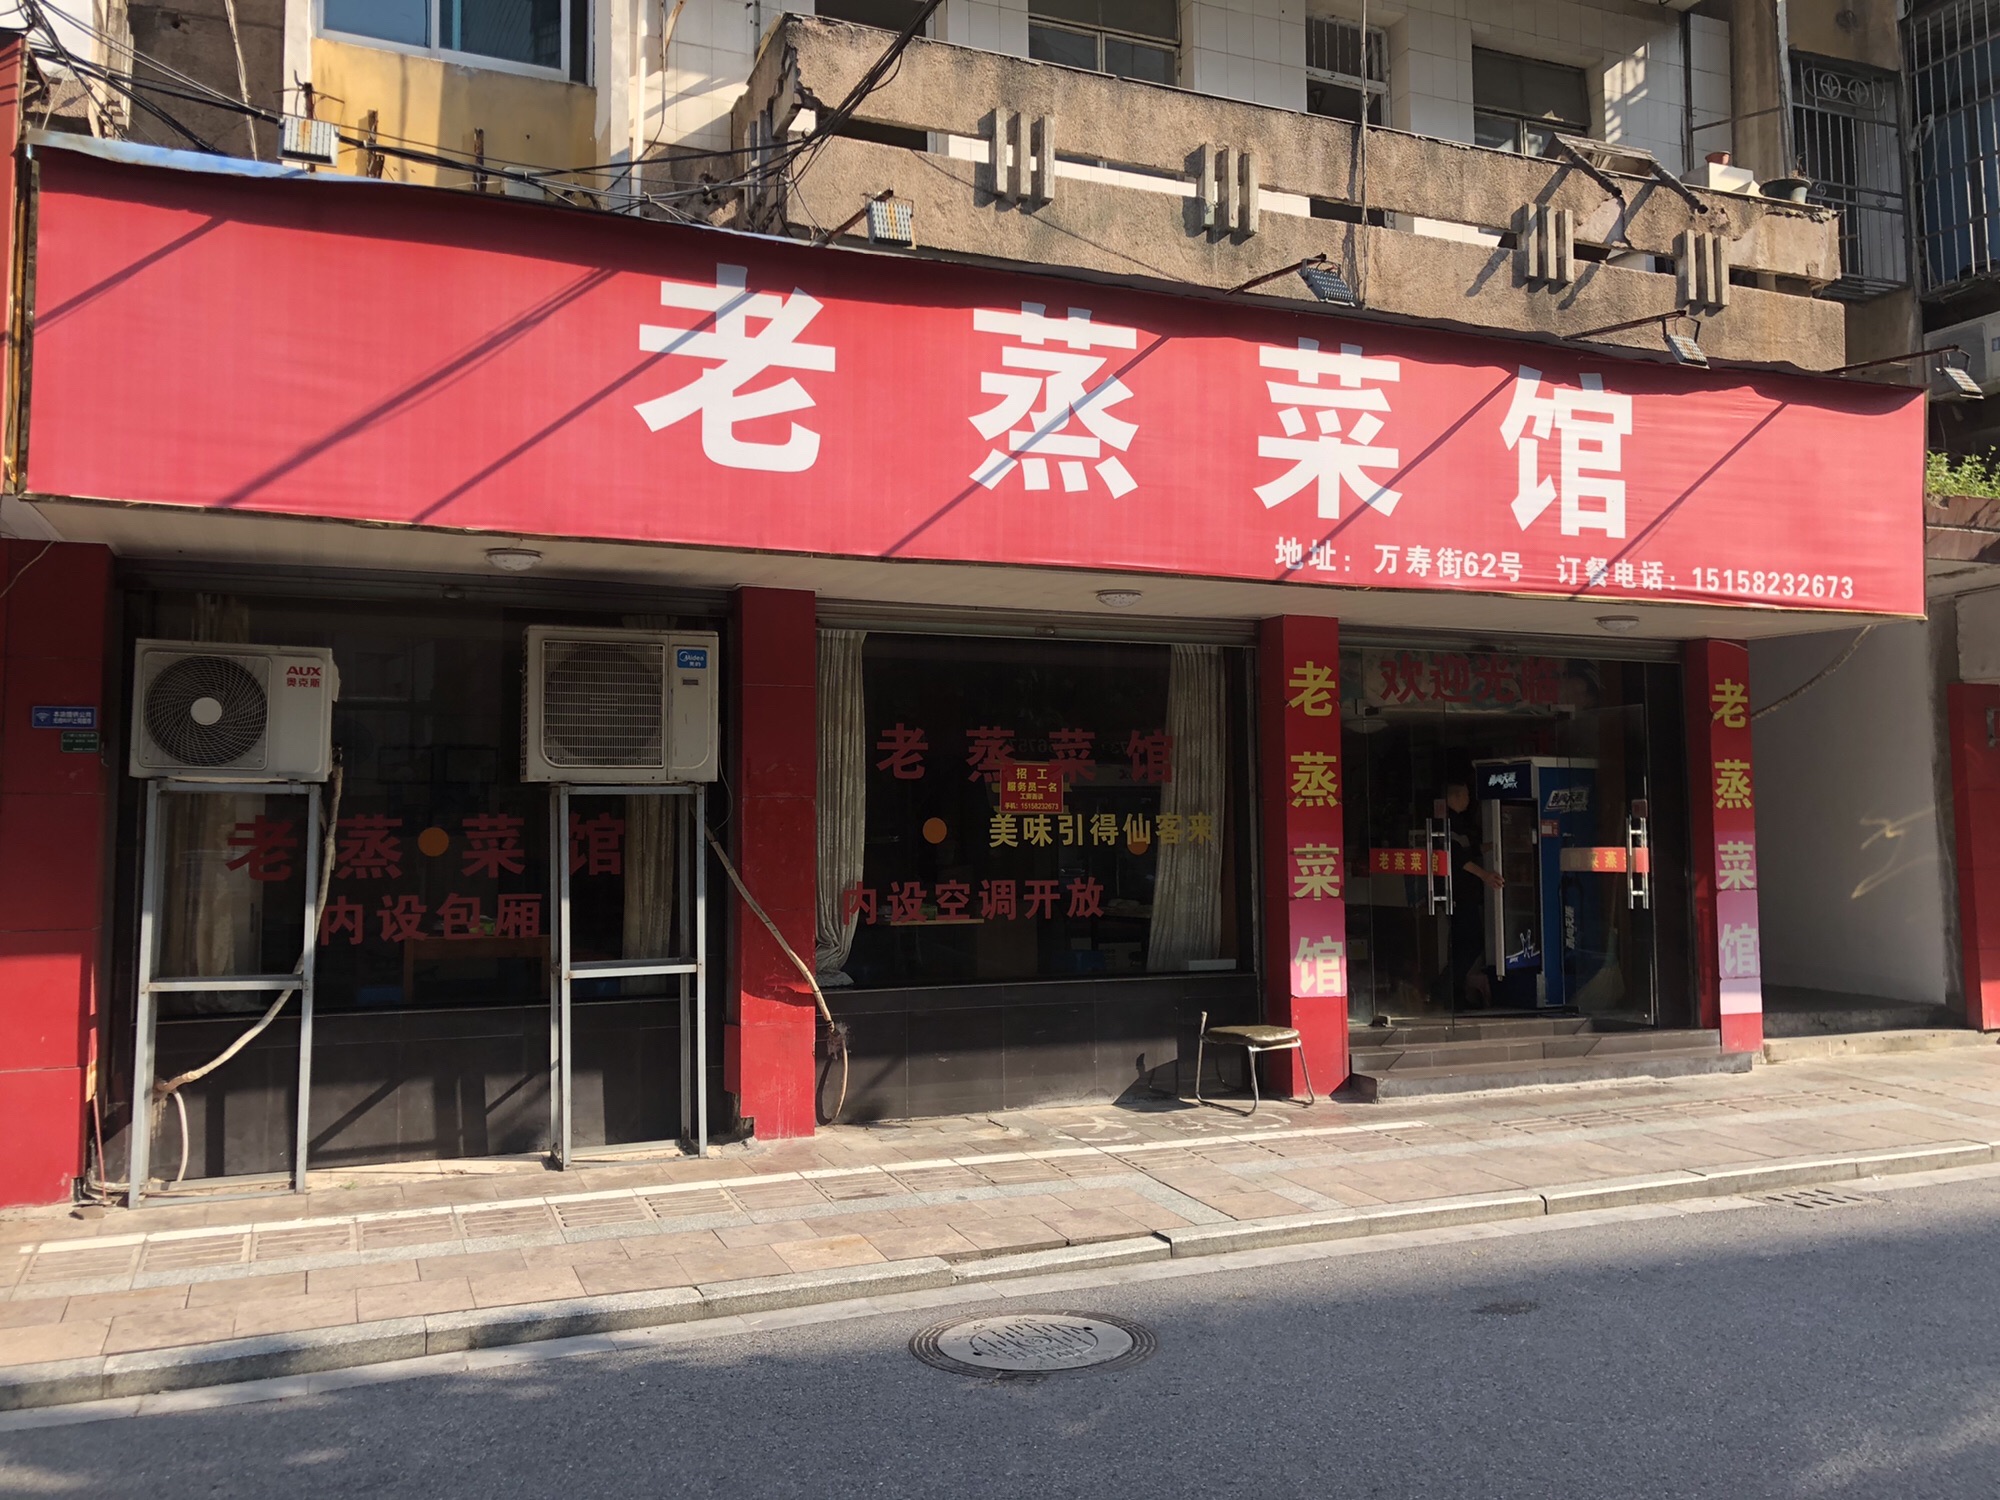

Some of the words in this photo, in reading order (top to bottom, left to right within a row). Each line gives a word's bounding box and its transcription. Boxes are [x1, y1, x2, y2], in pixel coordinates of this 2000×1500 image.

[634, 263, 1634, 540] 老蒸菜馆
[286, 666, 321, 676] AUX
[287, 677, 320, 688] 奥克斯
[1380, 652, 1561, 704] 欢迎光临
[876, 723, 1175, 784] 老蒸菜馆
[1007, 781, 1058, 793] 服务员一名
[226, 813, 626, 882] 老蒸菜馆
[989, 812, 1214, 848] 美味引得仙客来
[1289, 661, 1343, 995] 老蒸菜馆
[1712, 678, 1757, 976] 老蒸菜馆
[320, 893, 542, 947] 内设包厢
[842, 877, 1105, 927] 内设空调开放
